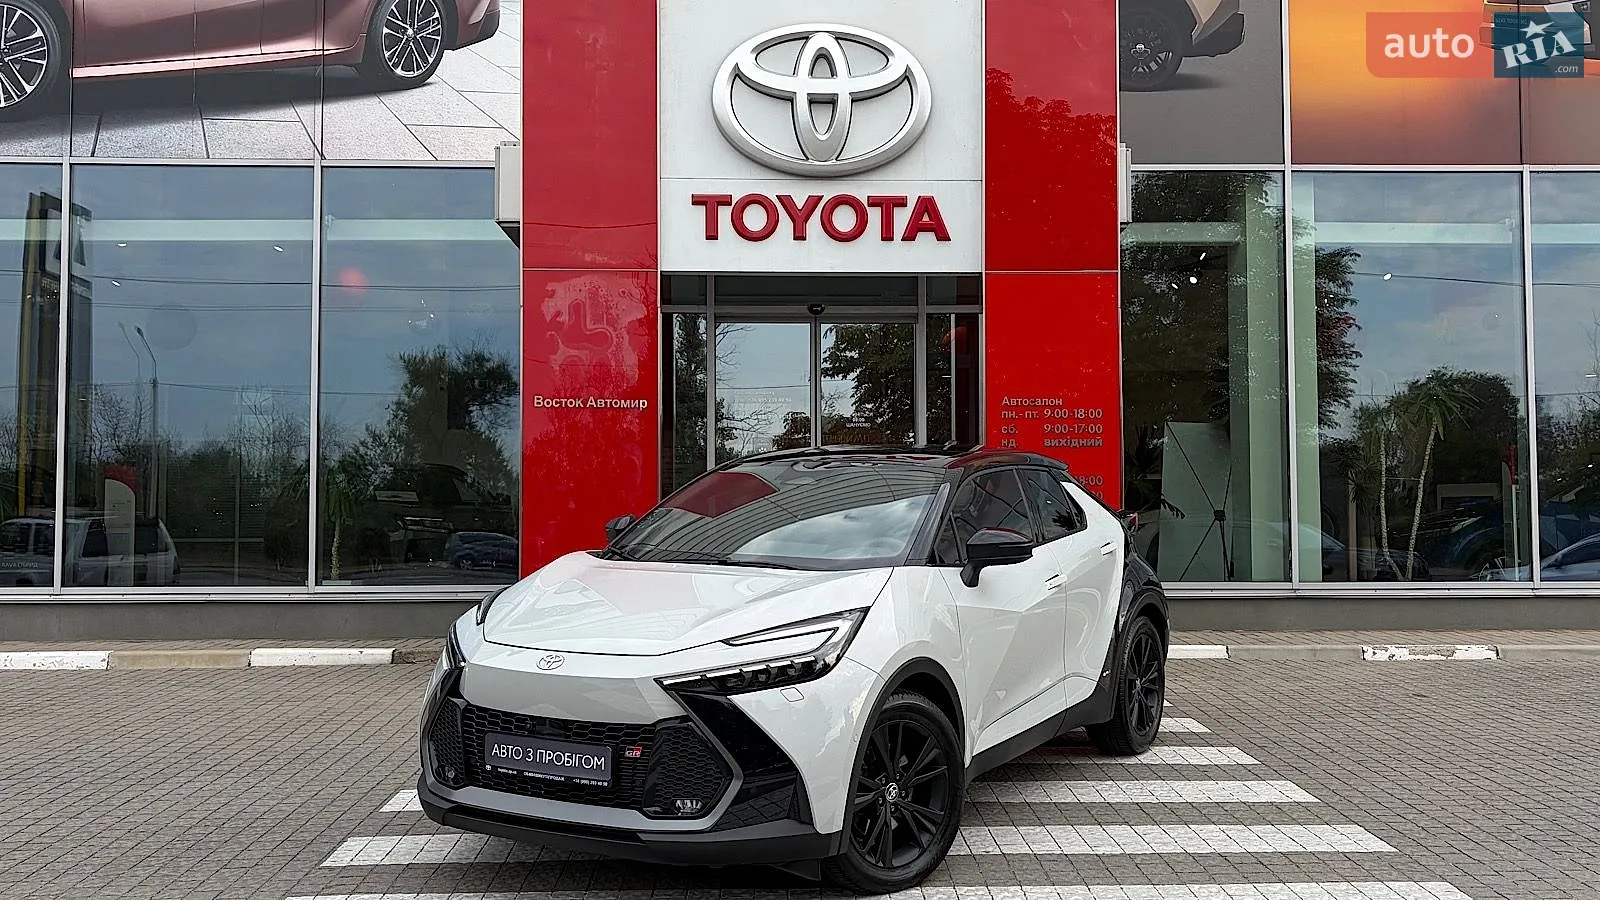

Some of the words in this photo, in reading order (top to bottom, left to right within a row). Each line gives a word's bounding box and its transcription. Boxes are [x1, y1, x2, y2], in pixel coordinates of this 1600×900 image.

[691, 193, 951, 242] TOYOTA
[534, 395, 584, 408] Восток
[586, 396, 648, 411] Автомир
[1001, 396, 1063, 406] Автосалон
[1001, 424, 1019, 434] сб.
[1044, 436, 1103, 447] вихідний
[1074, 475, 1104, 485] 8:00
[491, 743, 523, 760] АВТО
[536, 749, 605, 771] ПРОБІГОМ
